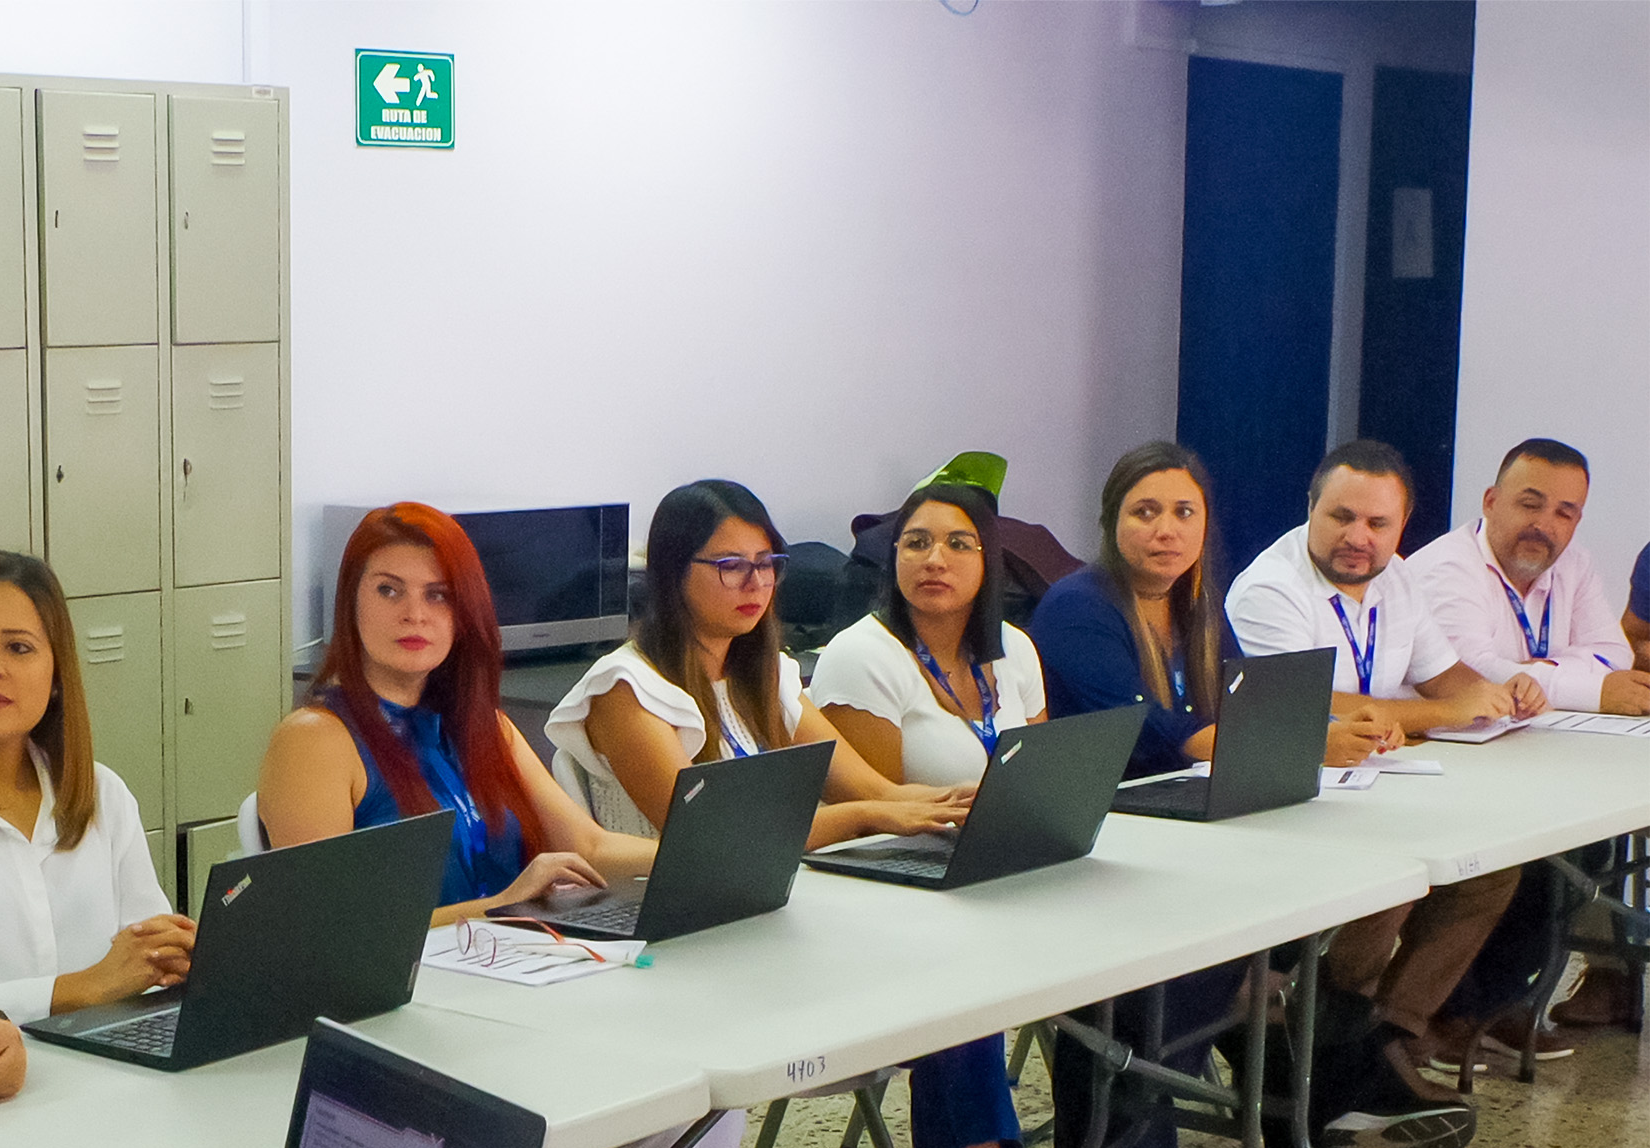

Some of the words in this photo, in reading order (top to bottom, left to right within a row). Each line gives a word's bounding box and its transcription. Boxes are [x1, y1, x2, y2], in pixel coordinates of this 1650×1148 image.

[382, 108, 412, 123] RUTA
[413, 109, 428, 124] DE
[370, 125, 442, 142] EVACUACION
